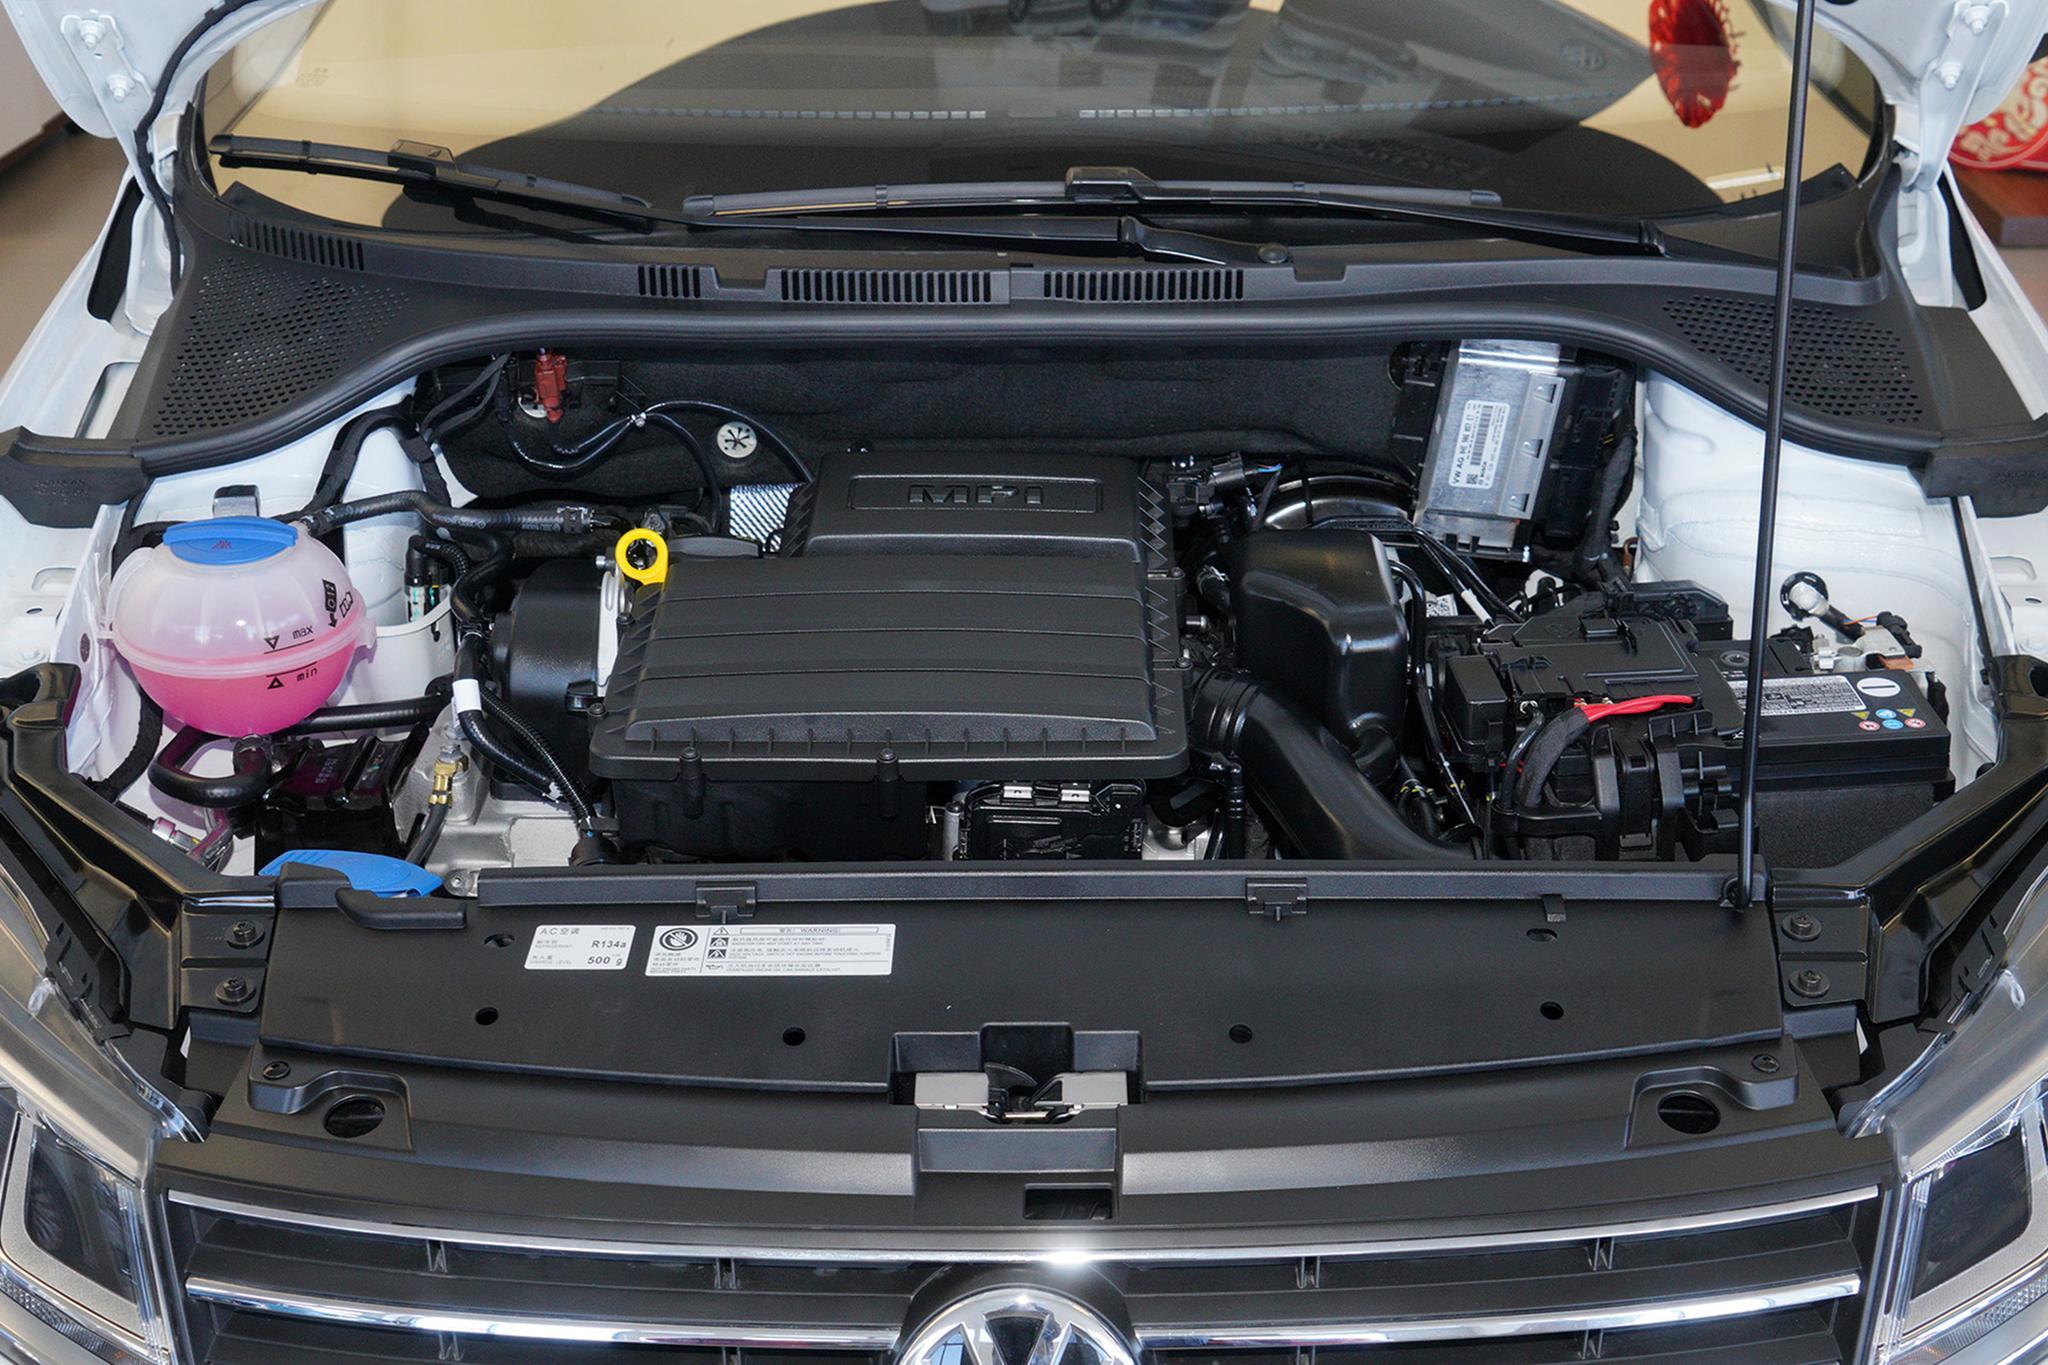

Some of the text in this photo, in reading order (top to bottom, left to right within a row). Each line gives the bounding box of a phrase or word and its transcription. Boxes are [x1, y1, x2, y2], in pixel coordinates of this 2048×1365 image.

[908, 483, 1043, 504] MPI
[292, 625, 314, 639] max
[296, 667, 318, 681] min
[591, 939, 627, 949] R134a
[587, 955, 611, 965] 500
